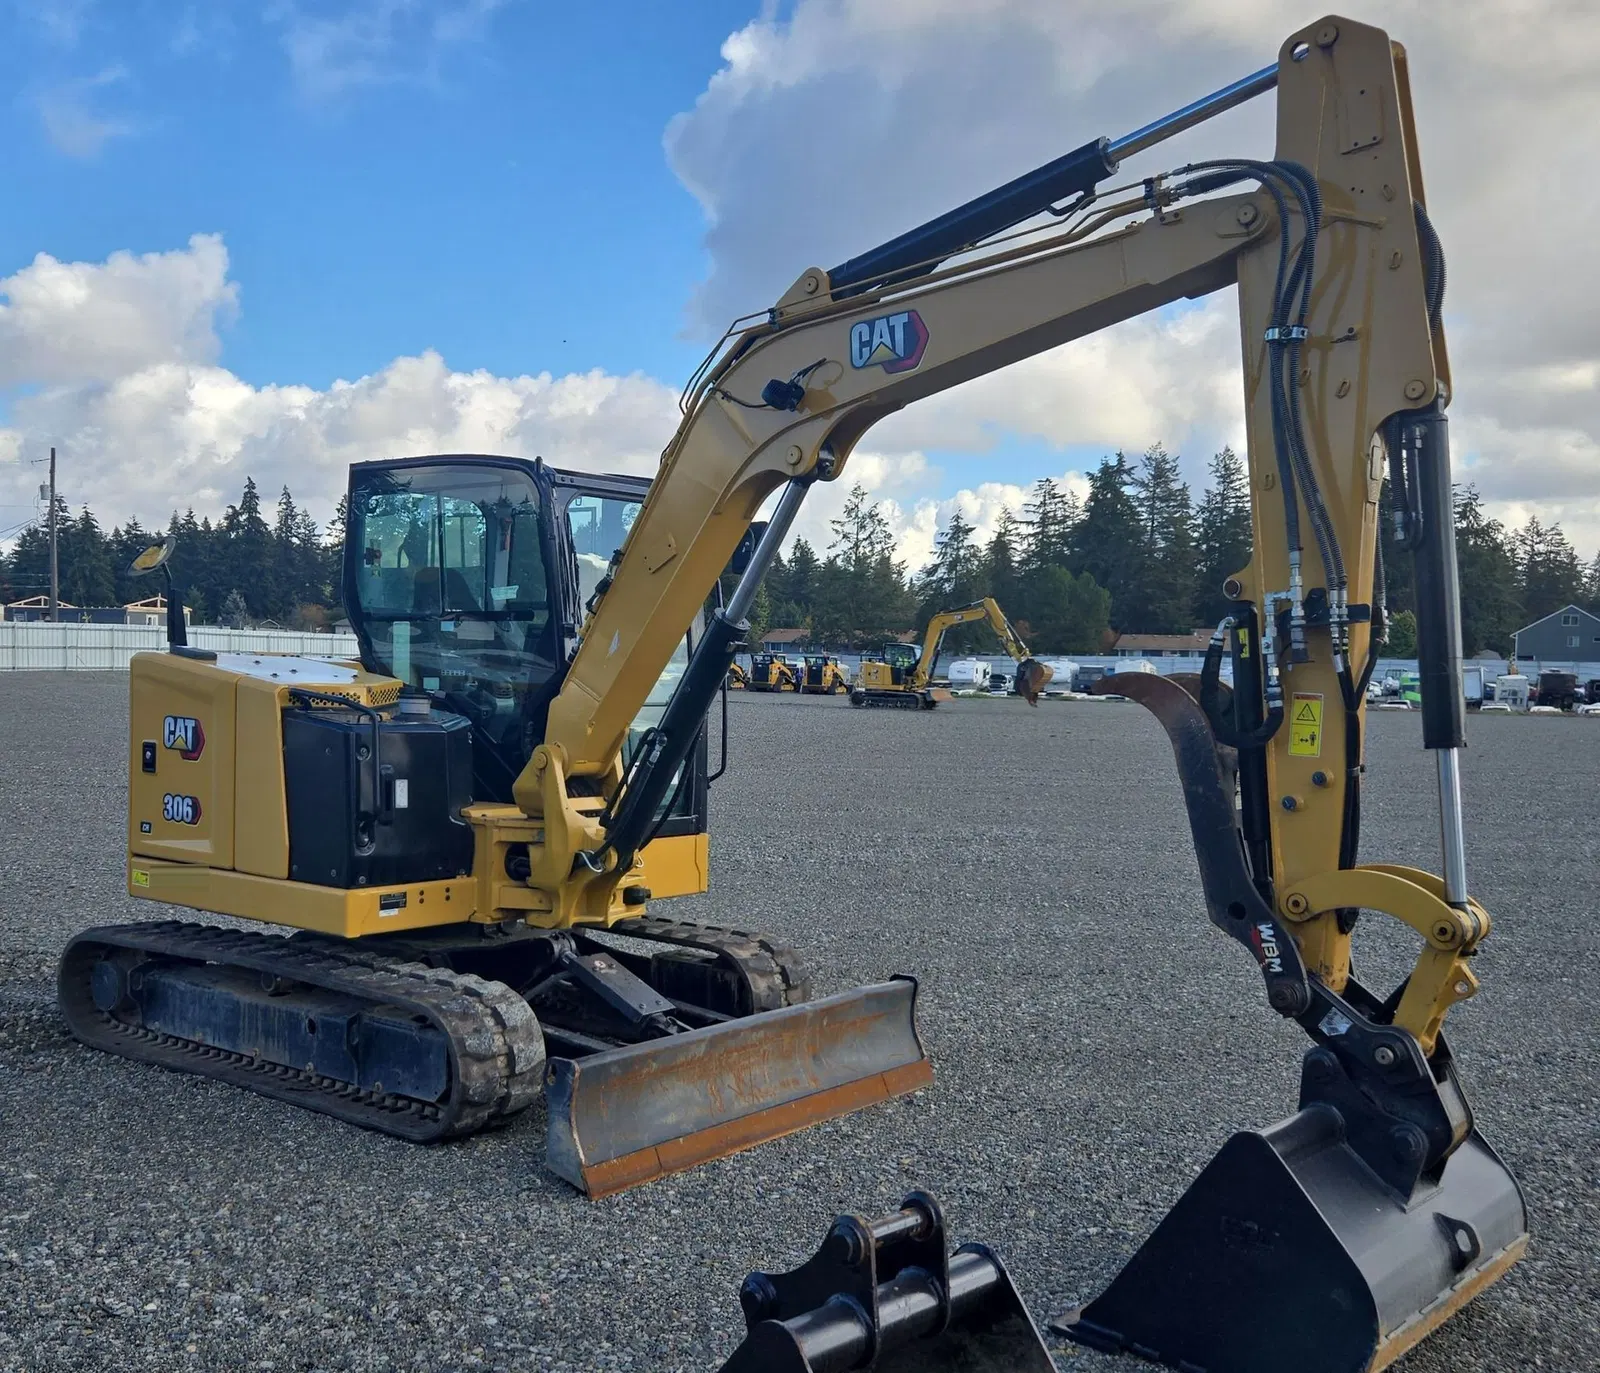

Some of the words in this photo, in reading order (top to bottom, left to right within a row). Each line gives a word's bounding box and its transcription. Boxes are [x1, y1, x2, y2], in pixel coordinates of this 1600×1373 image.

[851, 312, 909, 368] CAT
[164, 716, 195, 751] CAT
[163, 794, 193, 822] 306
[1258, 923, 1283, 973] WBM
